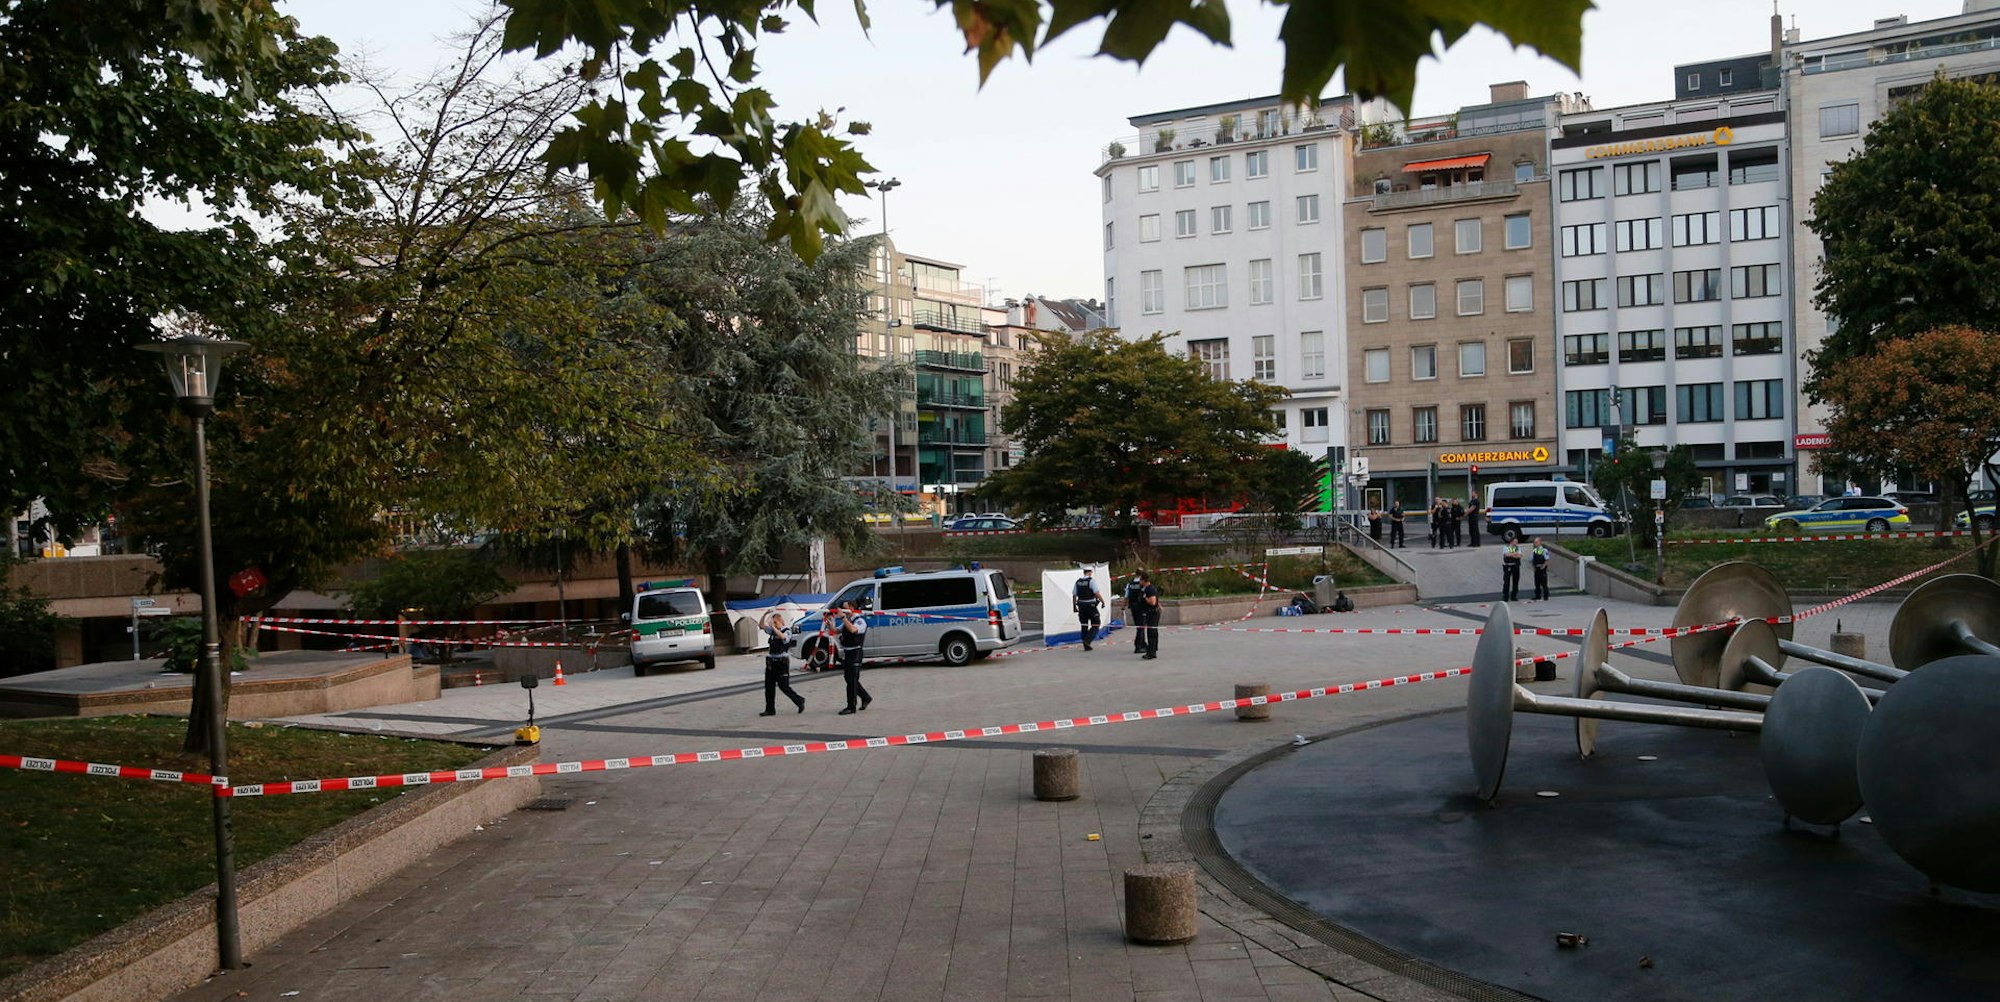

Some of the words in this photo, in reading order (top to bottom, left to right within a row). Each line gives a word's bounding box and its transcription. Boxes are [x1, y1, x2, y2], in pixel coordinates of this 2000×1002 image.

[1585, 134, 1707, 159] COMMERZBANK
[1440, 451, 1529, 463] COMMERZBANK
[675, 618, 702, 626] POLIZEI
[889, 616, 925, 626] POLIZEI
[26, 759, 52, 769] POLIZEI
[92, 765, 117, 775] POLIZEI
[237, 786, 260, 794] POLIZEI
[295, 782, 318, 790] POLIZEI
[352, 778, 374, 787] POLIZEI
[406, 774, 428, 783] POLIZEI
[459, 771, 480, 779] POLIZEI
[510, 767, 531, 775] POLIZEI
[559, 764, 580, 772] POLIZEI
[607, 760, 628, 768] POLIZEI
[654, 755, 674, 764] POLIZEI
[700, 752, 718, 760] POLIZEI
[744, 749, 762, 757] POLIZEI
[828, 742, 846, 750] POLIZEI
